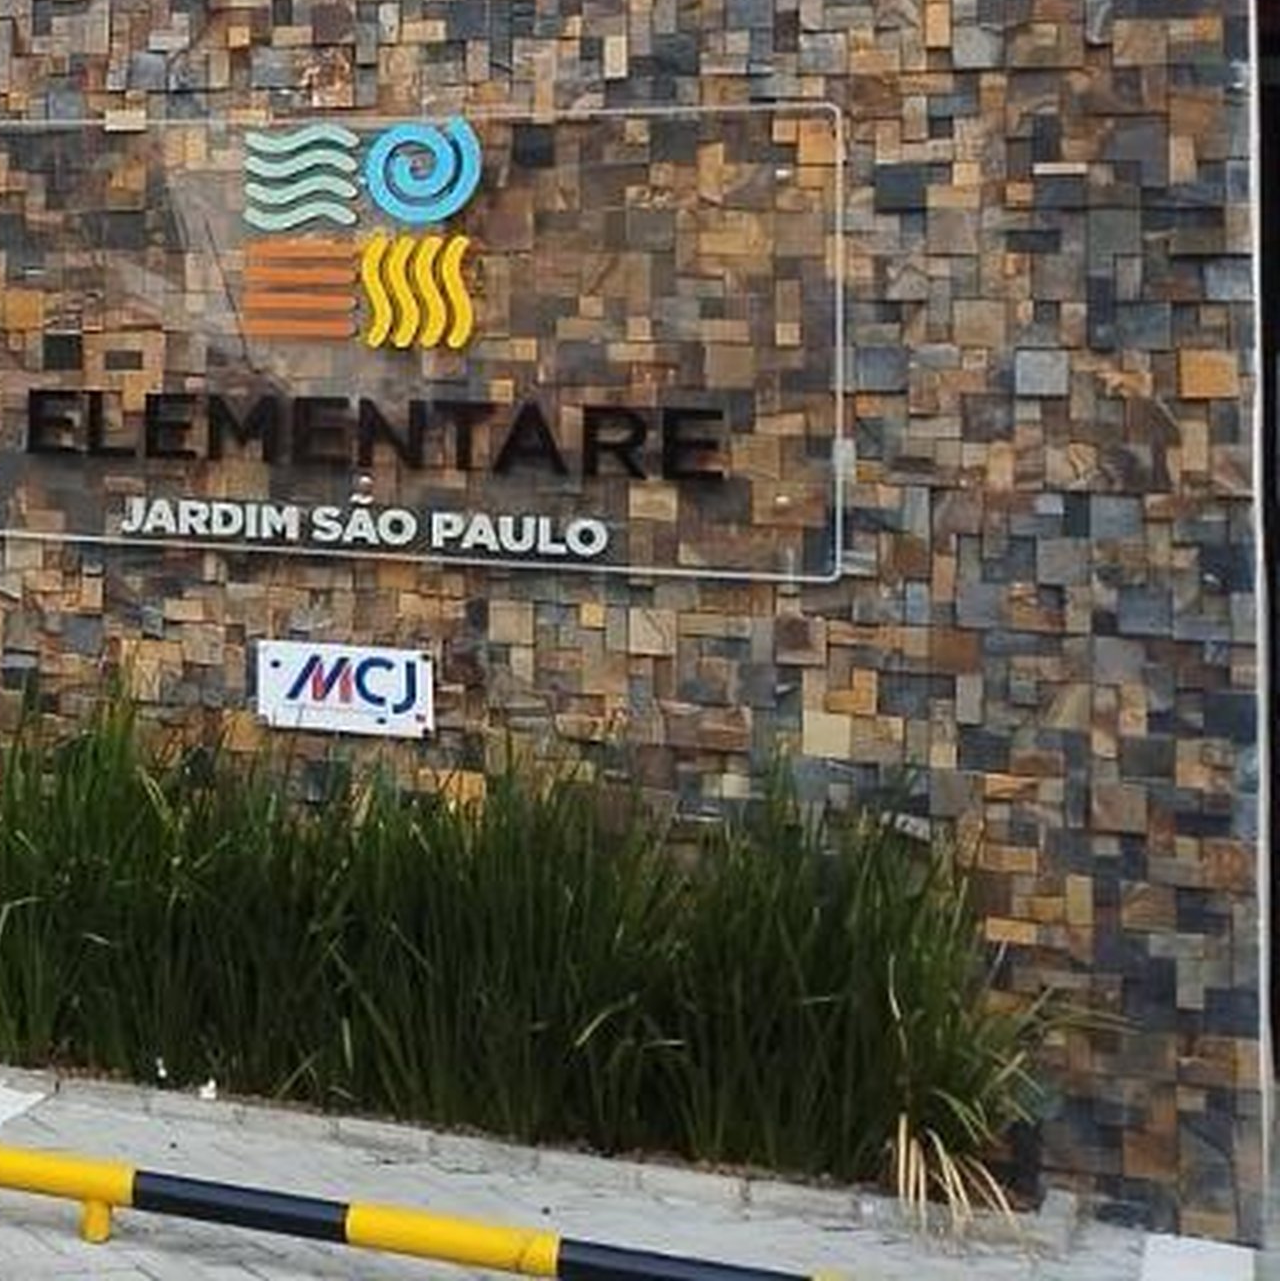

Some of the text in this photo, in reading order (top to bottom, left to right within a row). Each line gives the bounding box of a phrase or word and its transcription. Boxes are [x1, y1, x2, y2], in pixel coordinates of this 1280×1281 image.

[26, 388, 726, 481] ELEMENTARE
[121, 492, 609, 557] JARDIM SÃO PAULO
[286, 653, 417, 715] MCJ
